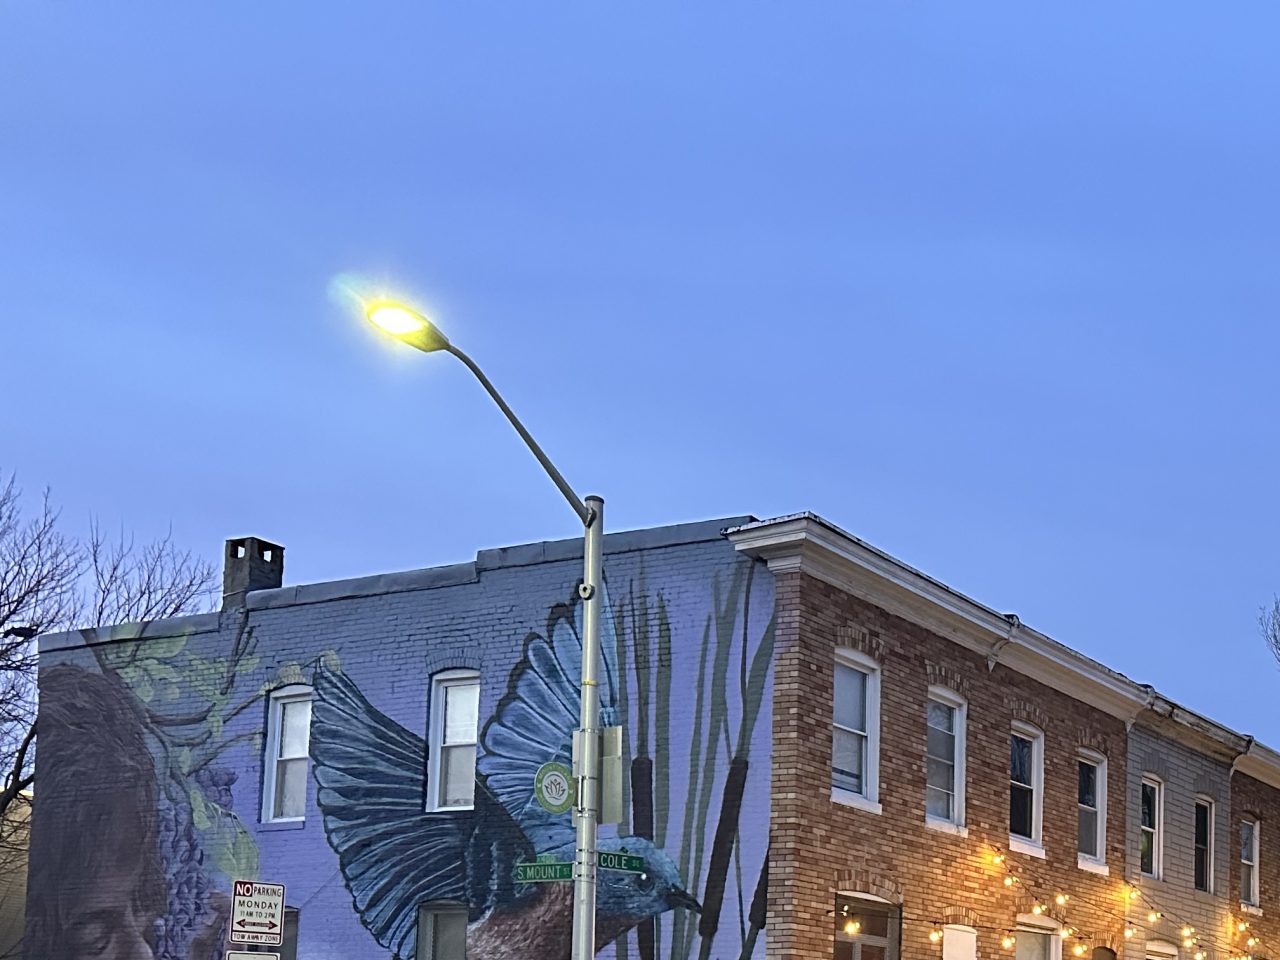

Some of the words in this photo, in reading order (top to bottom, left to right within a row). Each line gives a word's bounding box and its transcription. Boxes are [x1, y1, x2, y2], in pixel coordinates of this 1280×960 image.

[600, 854, 628, 869] COLE
[517, 867, 524, 880] S
[526, 866, 561, 879] MOUNT
[236, 883, 252, 896] NO
[254, 886, 282, 897] PARKING
[238, 900, 279, 910] MONDAY
